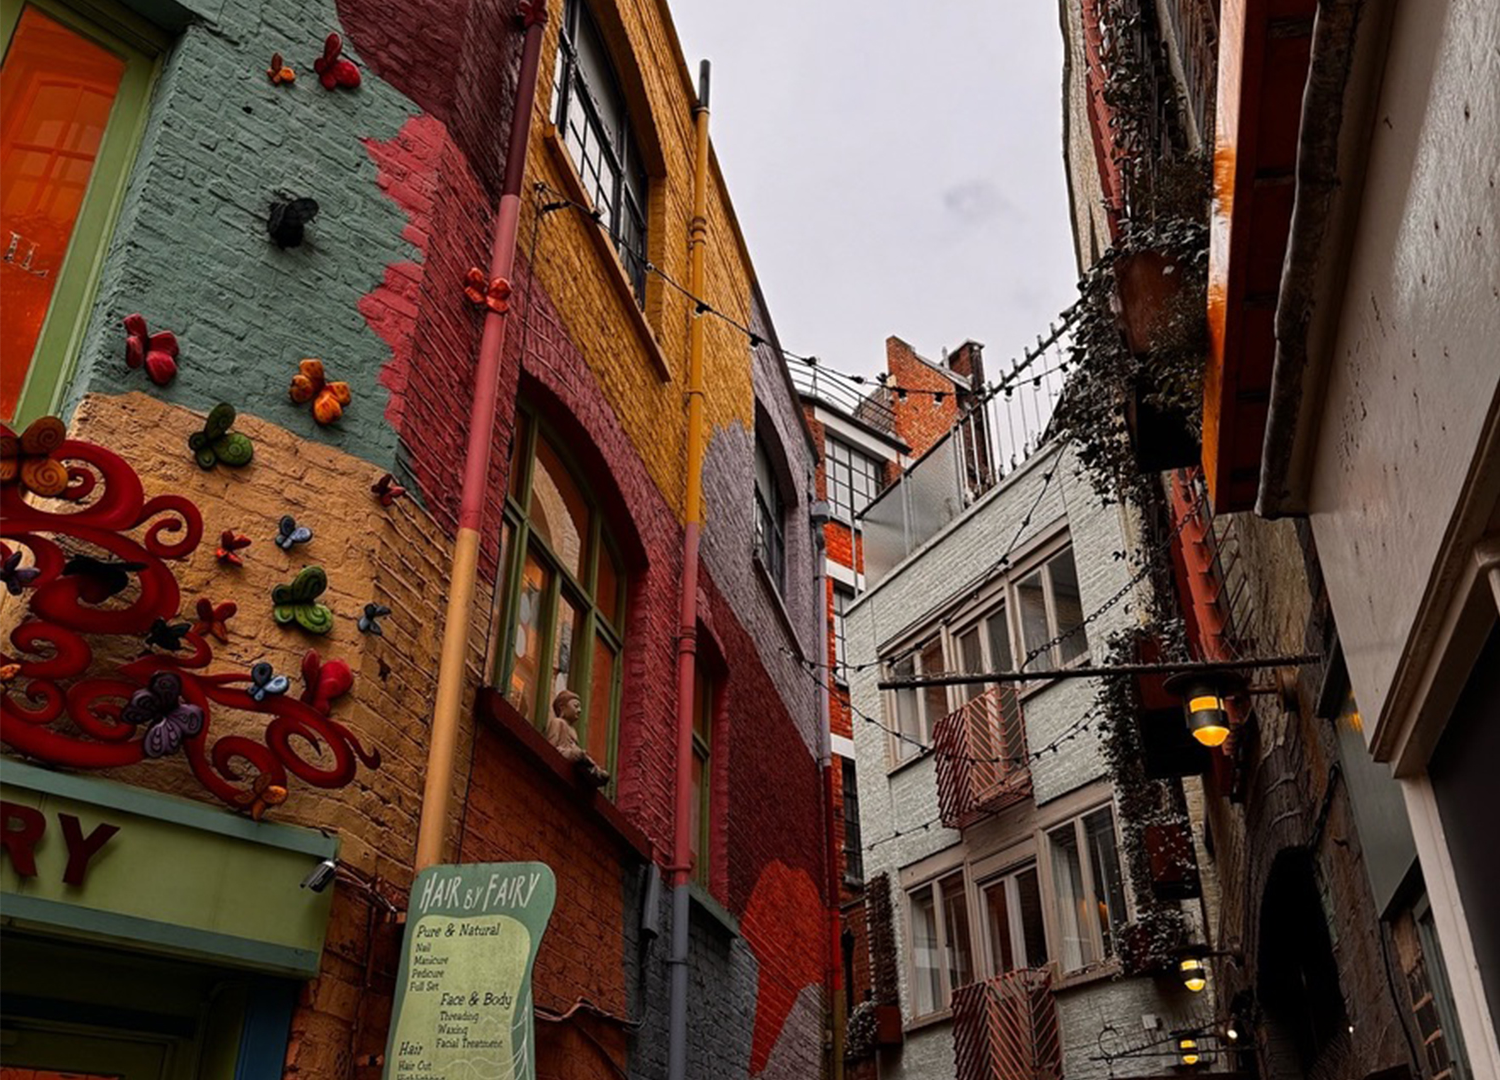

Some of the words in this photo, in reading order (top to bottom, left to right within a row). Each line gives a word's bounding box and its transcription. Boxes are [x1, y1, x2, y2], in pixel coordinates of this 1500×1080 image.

[419, 872, 462, 914] HAIR
[463, 886, 484, 910] BY
[482, 873, 540, 912] FAIRY
[417, 925, 441, 938] Pure
[444, 923, 455, 937] &
[459, 923, 500, 937] Natural
[415, 943, 431, 953] Nail
[414, 955, 449, 965] Manicure
[411, 969, 445, 979] Pedicure
[410, 981, 424, 992] Full
[427, 981, 439, 991] Set
[440, 992, 465, 1006] Face
[468, 991, 479, 1006] &
[483, 992, 512, 1010] Body
[440, 1011, 479, 1023] Threading
[438, 1024, 468, 1035] Waxing
[399, 1041, 423, 1056] Hair
[436, 1038, 459, 1048] Facial
[462, 1038, 503, 1049] Treatment
[398, 1060, 415, 1071] Hair
[417, 1060, 432, 1071] Cut
